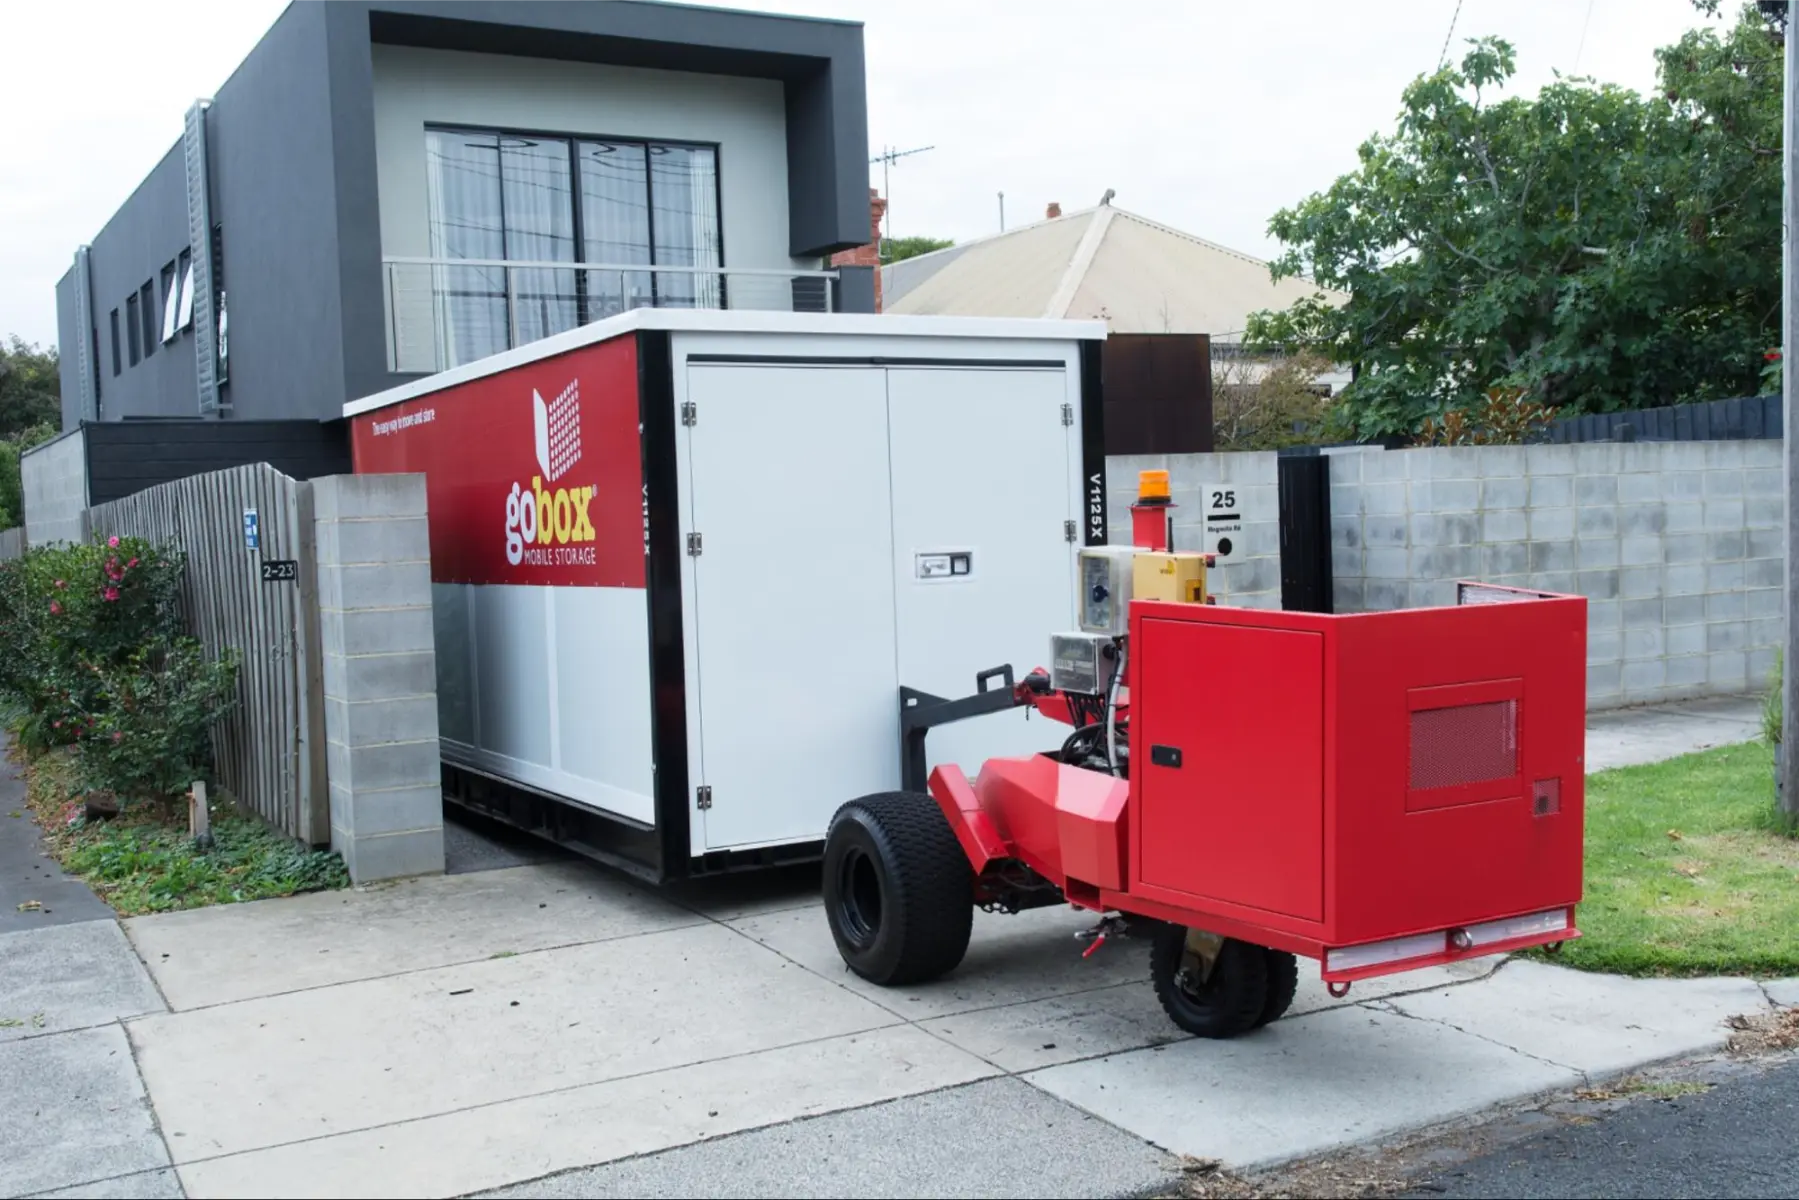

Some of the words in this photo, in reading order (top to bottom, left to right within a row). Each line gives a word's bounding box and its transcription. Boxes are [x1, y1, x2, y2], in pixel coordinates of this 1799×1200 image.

[1090, 473, 1103, 538] V1125X
[1212, 491, 1236, 508] 25
[524, 548, 553, 566] MOBILE
[554, 547, 596, 565] STORAGE
[263, 564, 294, 577] 2-23
